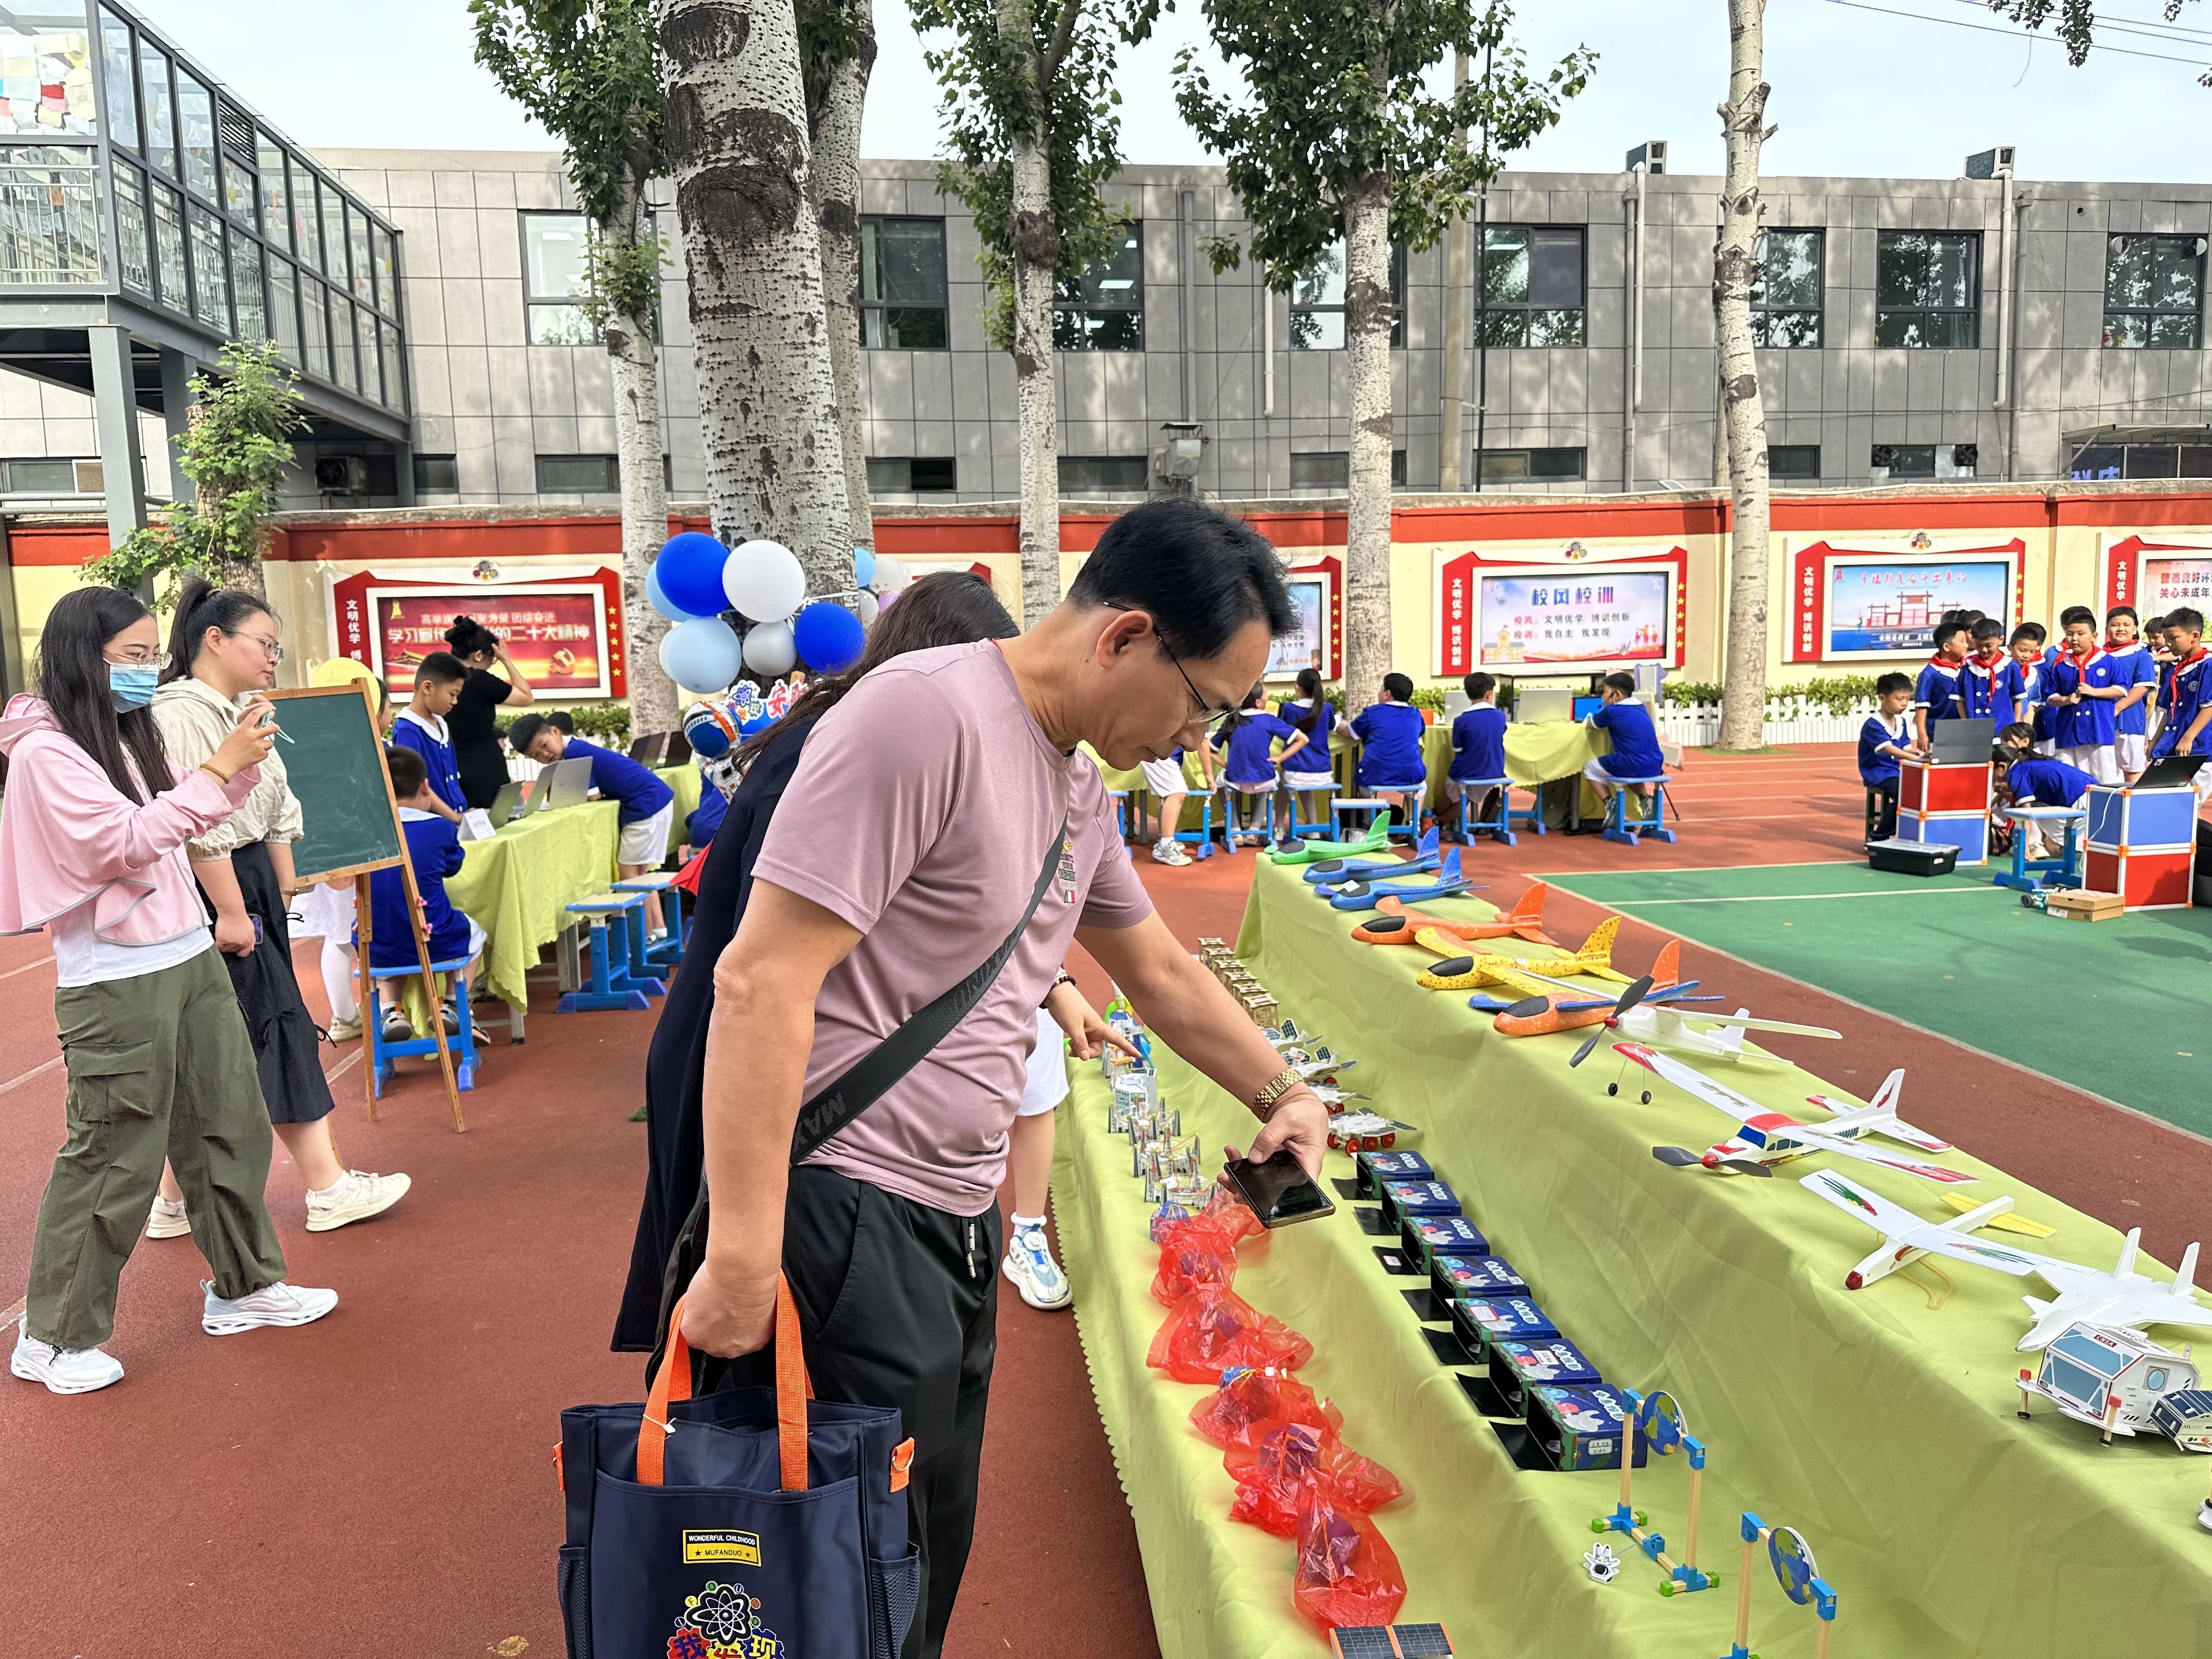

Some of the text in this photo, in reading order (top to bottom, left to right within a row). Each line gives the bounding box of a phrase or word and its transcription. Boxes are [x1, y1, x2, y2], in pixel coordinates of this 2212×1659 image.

[2116, 560, 2127, 601] 文明优学
[2160, 572, 2212, 584] 营造良好环
[1531, 586, 1613, 606] 校风校训
[2160, 588, 2212, 599] 关心未成年
[1802, 566, 1814, 653] 文明优学 博识创新
[346, 599, 361, 644] 文明优学
[1451, 578, 1463, 667] 文明优学 博识创新
[1544, 614, 1583, 624] 文明优学
[1592, 612, 1629, 622] 博识创新
[1545, 630, 1573, 639] 我自主
[1582, 628, 1610, 637] 我发现
[2096, 1335, 2114, 1347] CNSA
[726, 1535, 755, 1545] CHILDHOOD
